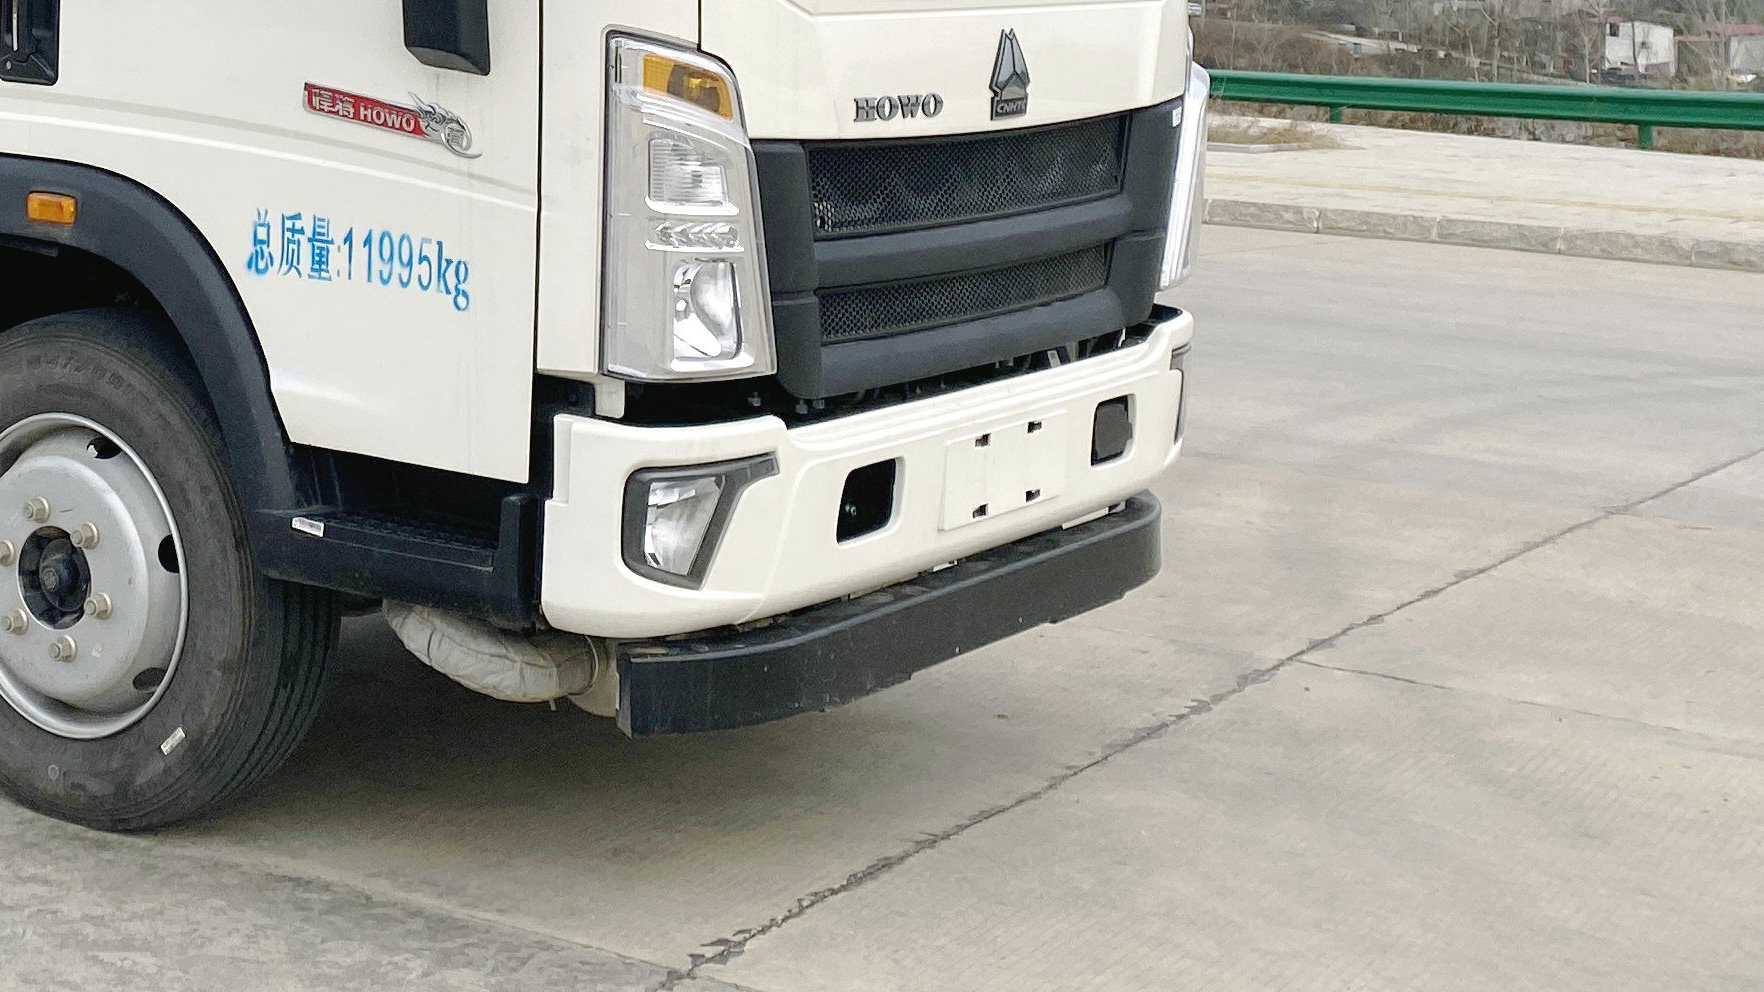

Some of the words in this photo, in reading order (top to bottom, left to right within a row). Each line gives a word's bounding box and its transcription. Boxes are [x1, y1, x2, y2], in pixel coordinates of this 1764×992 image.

[312, 88, 355, 118] 悍将
[359, 102, 415, 132] HOWO
[853, 92, 944, 123] HOWO
